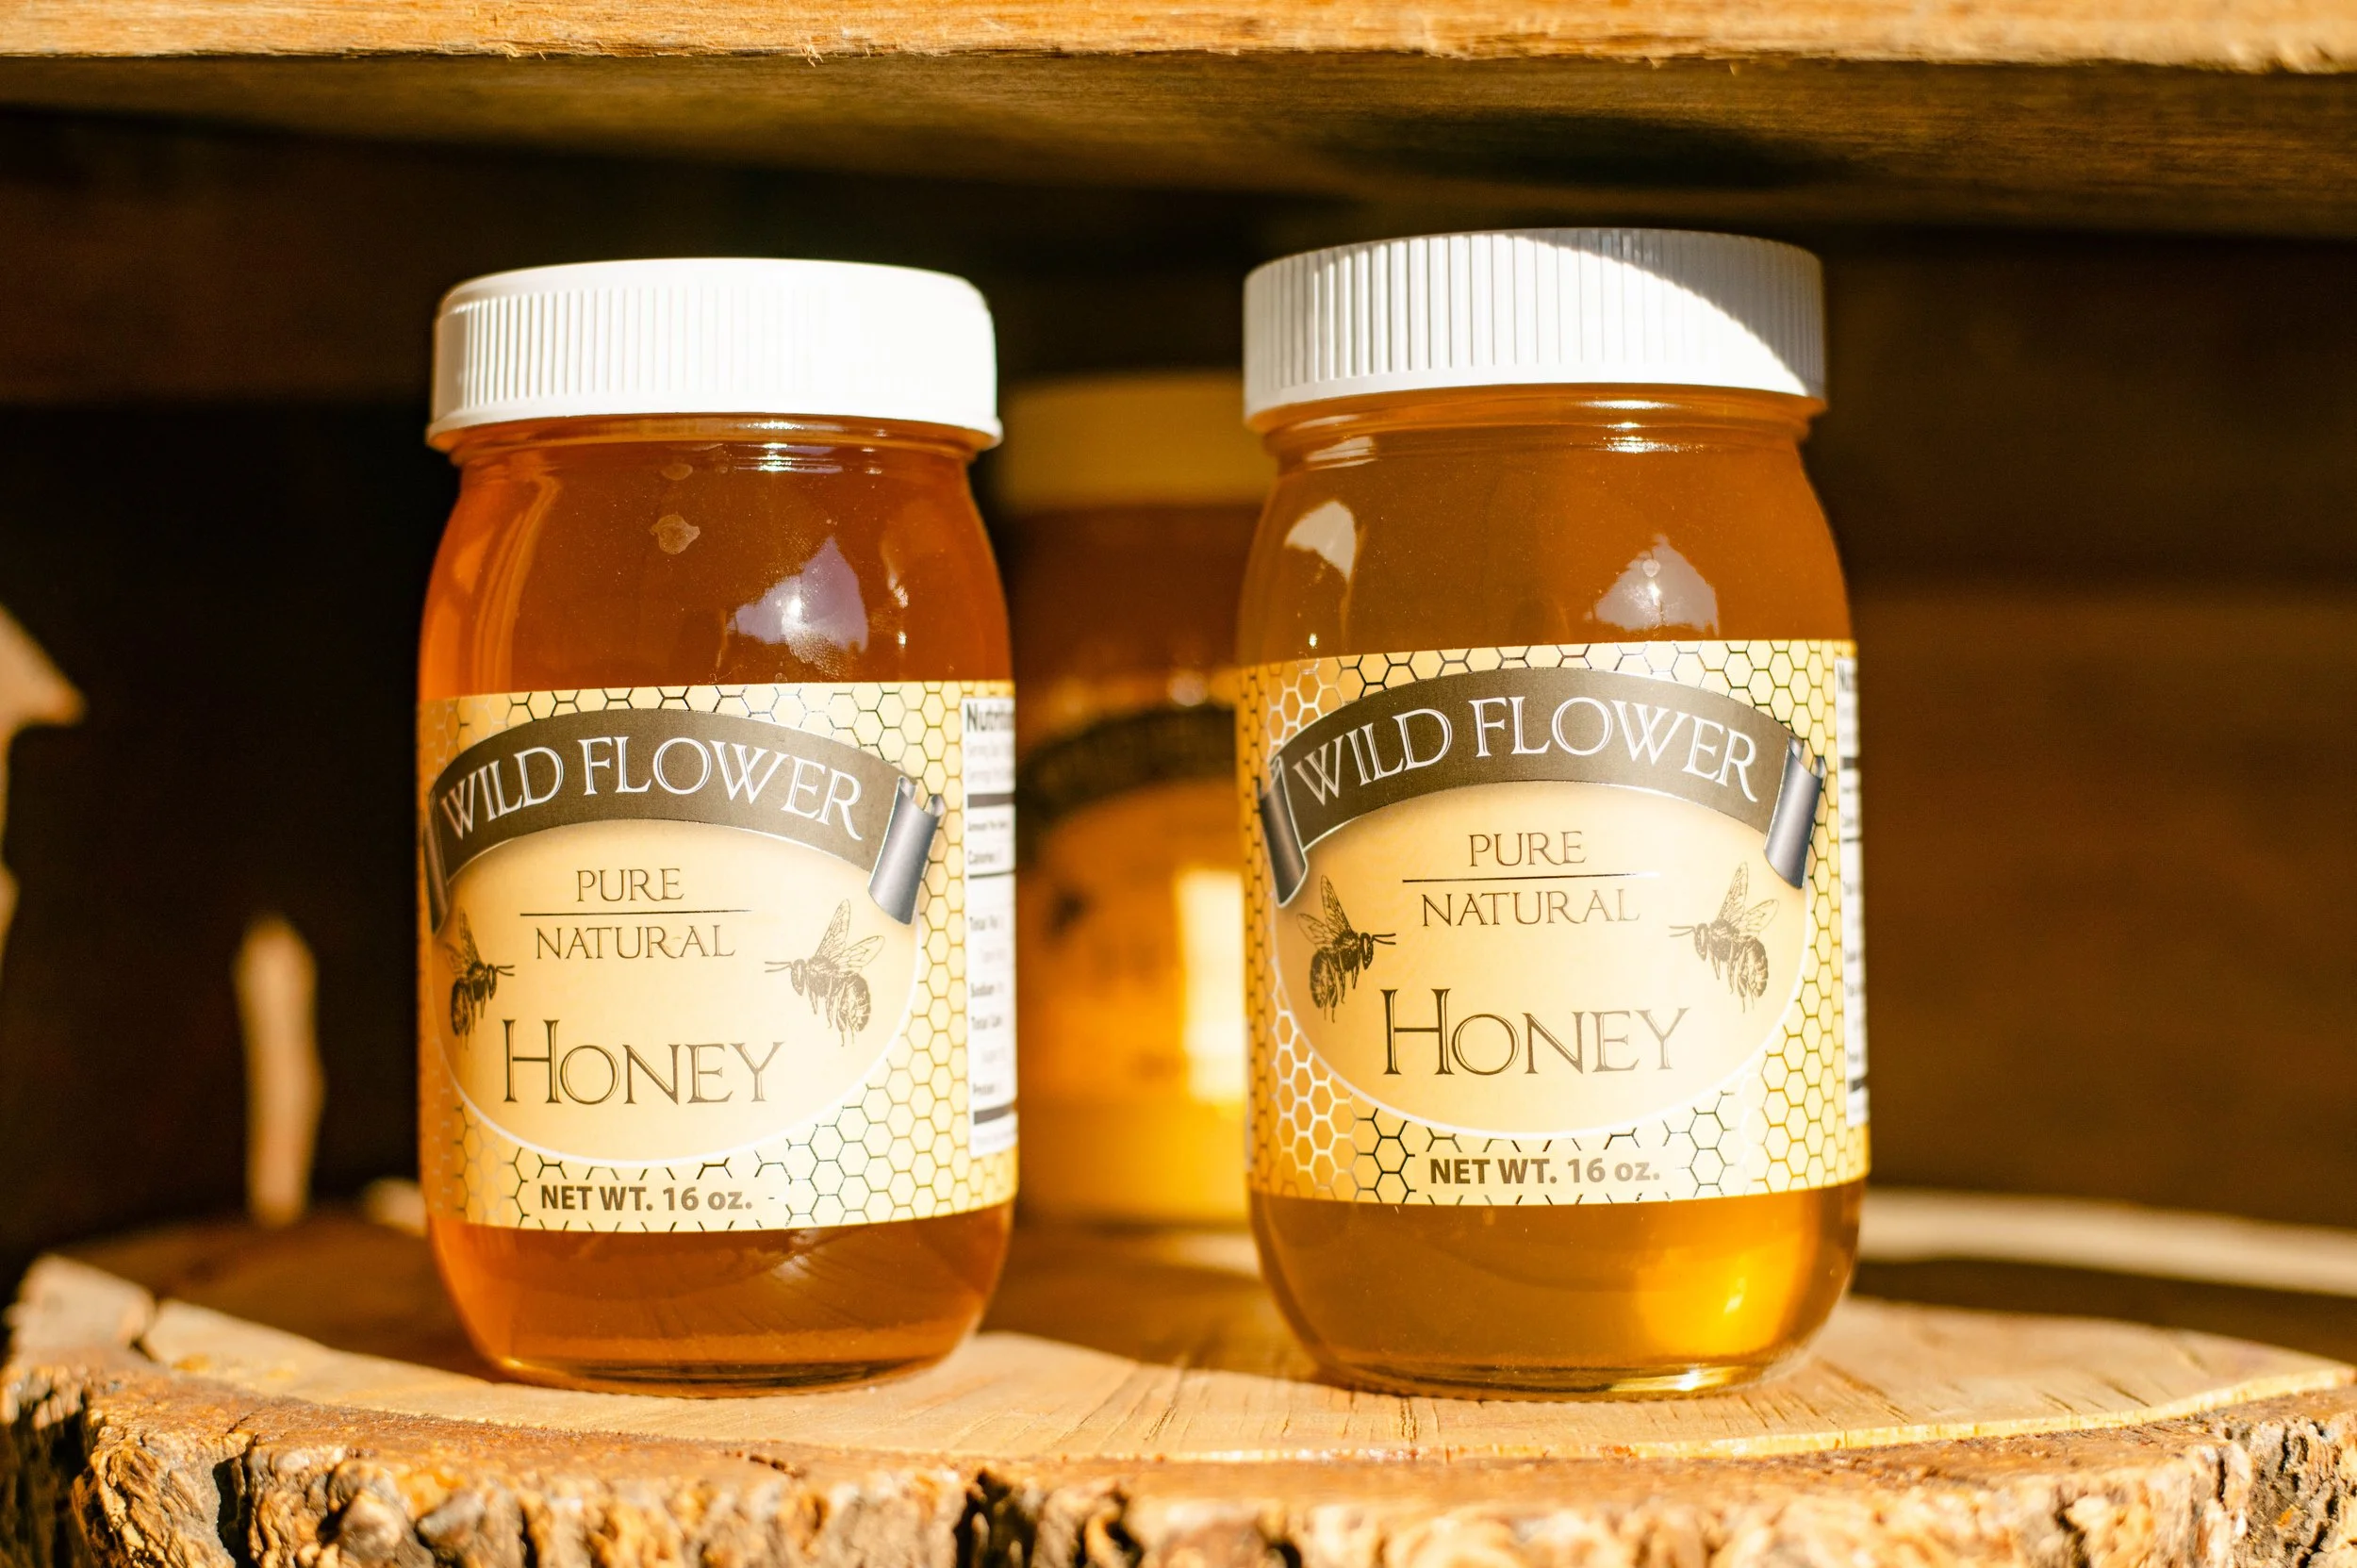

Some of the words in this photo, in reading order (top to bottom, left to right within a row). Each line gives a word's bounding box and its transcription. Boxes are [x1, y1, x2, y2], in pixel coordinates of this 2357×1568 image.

[1293, 707, 1453, 806] WILD
[1468, 695, 1758, 802] FLOWER
[440, 746, 564, 841] WILD
[577, 734, 863, 842] FLOWER
[1468, 830, 1586, 867] PURE
[575, 867, 685, 903] PURE
[1422, 888, 1640, 928] NATURAL
[535, 924, 736, 961] NATURAL
[1380, 987, 1690, 1077] HONEY
[501, 1018, 786, 1107] HONEY
[1429, 1158, 1491, 1184] NET
[1497, 1158, 1558, 1184] WT.
[1567, 1157, 1607, 1183] 16
[1613, 1161, 1660, 1182] oz.
[540, 1184, 593, 1211] NET
[599, 1186, 653, 1212] WT.
[662, 1186, 700, 1212] 16
[707, 1191, 752, 1211] oz.
